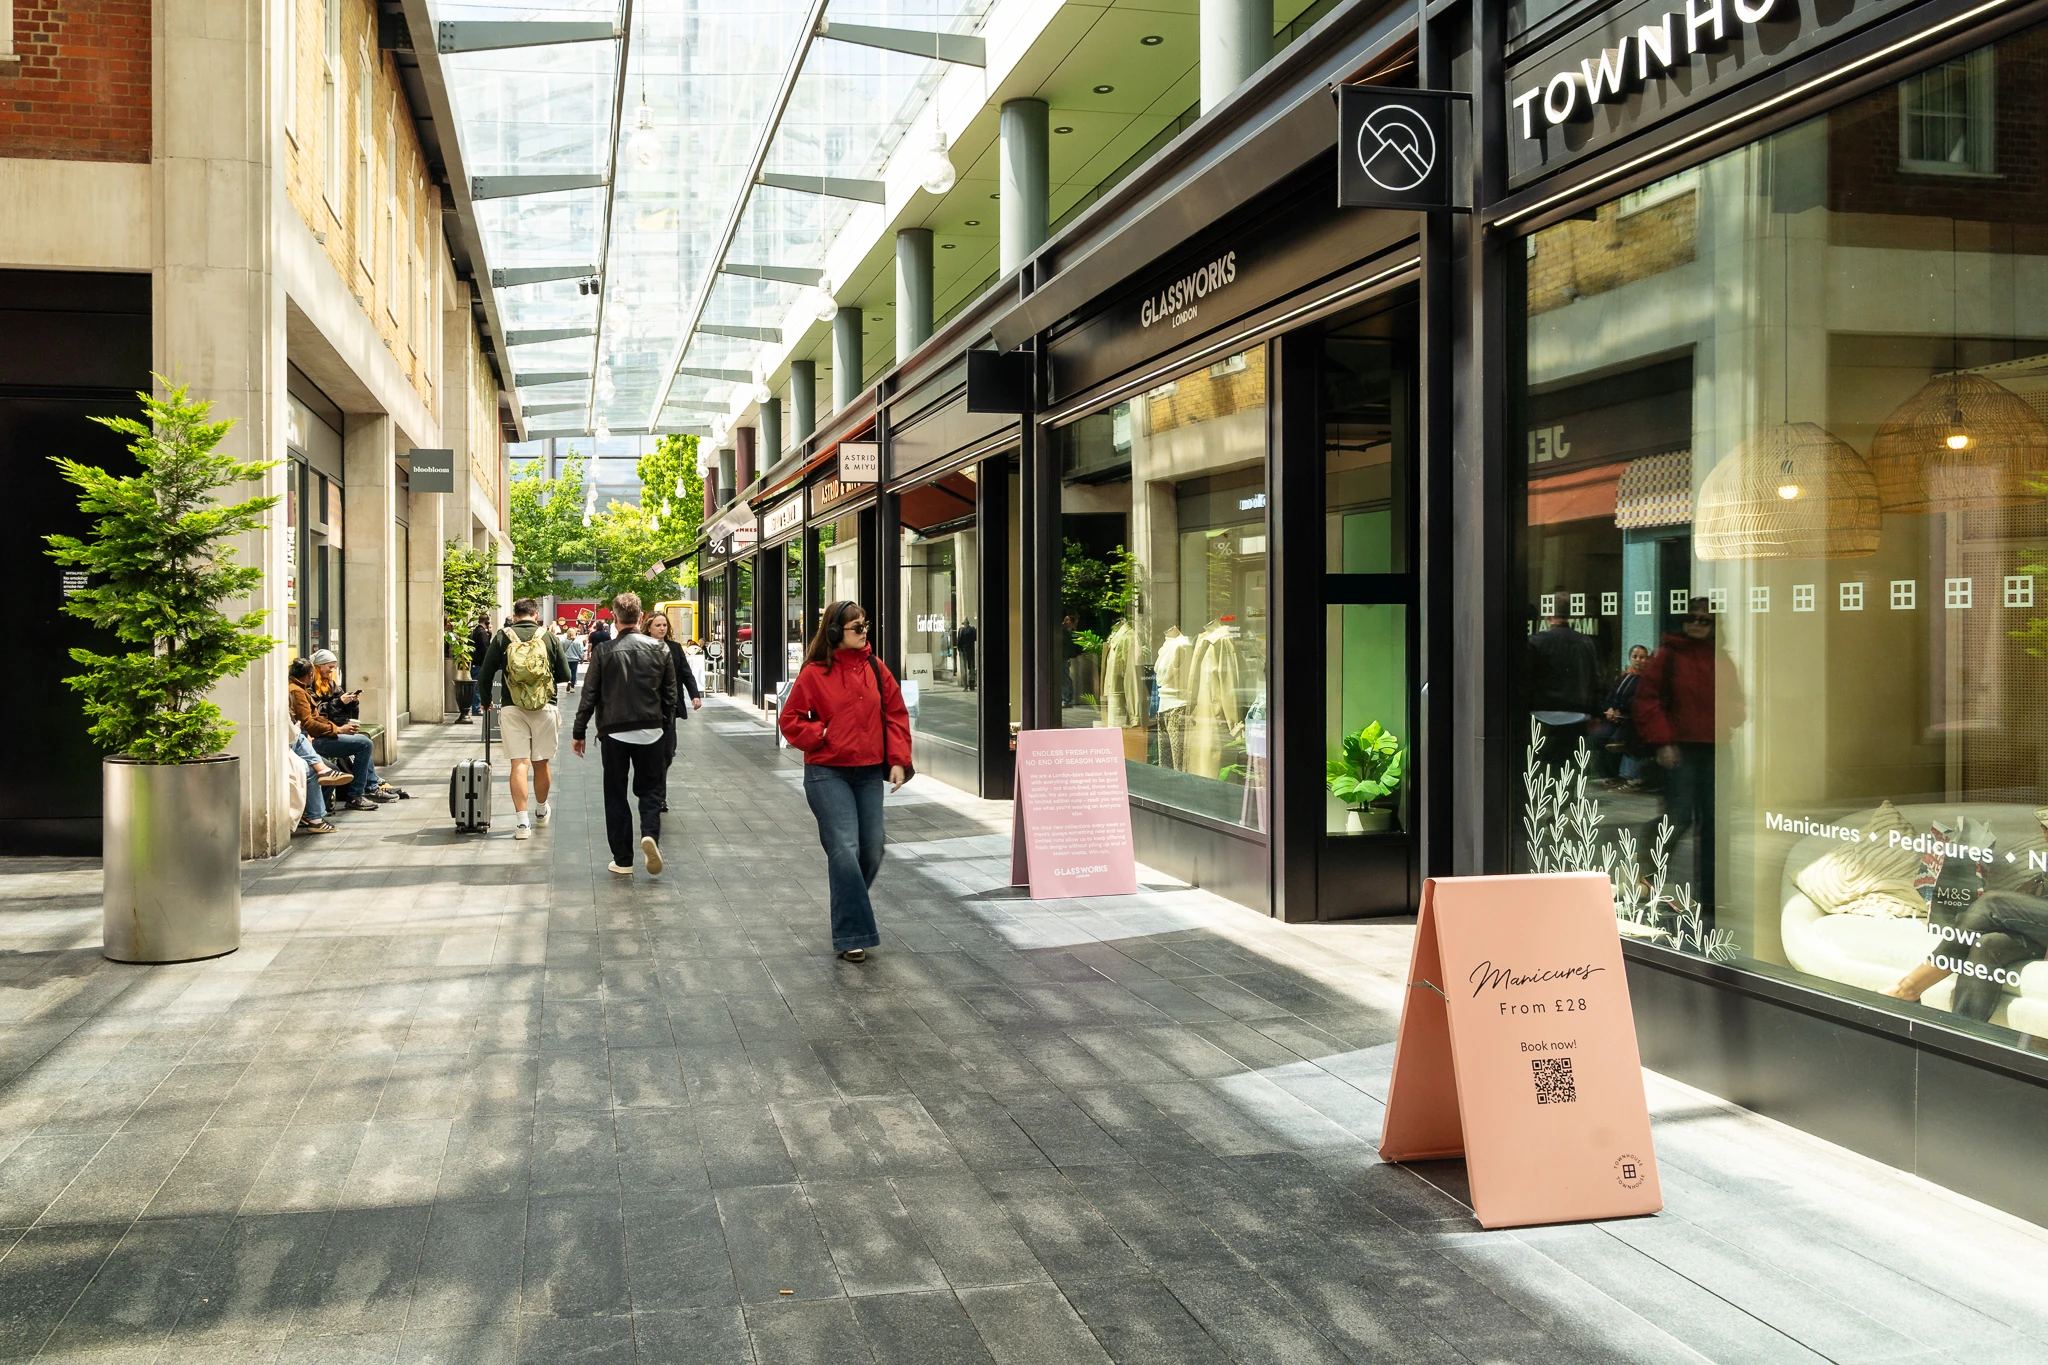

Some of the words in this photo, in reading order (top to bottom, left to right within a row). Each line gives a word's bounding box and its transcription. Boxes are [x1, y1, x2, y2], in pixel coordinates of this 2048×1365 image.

[1141, 250, 1236, 328] GLASSWORKS
[1172, 305, 1198, 328] LONDON
[1032, 749, 1064, 757] ENDLESS
[1065, 748, 1088, 756] FRESH
[1025, 759, 1036, 767] NO
[1065, 757, 1094, 765] SEASON
[1095, 756, 1119, 764] WASTE
[1765, 811, 1860, 843] Manicures
[1888, 829, 1994, 863] Pedicures
[1054, 864, 1109, 877] GLASSWORKS
[1937, 886, 1971, 901] M&S
[1469, 960, 1606, 998] Manicures
[1500, 1002, 1546, 1015] From
[1555, 998, 1587, 1012] £28
[1520, 1041, 1549, 1052] Book
[1550, 1039, 1577, 1050] now!
